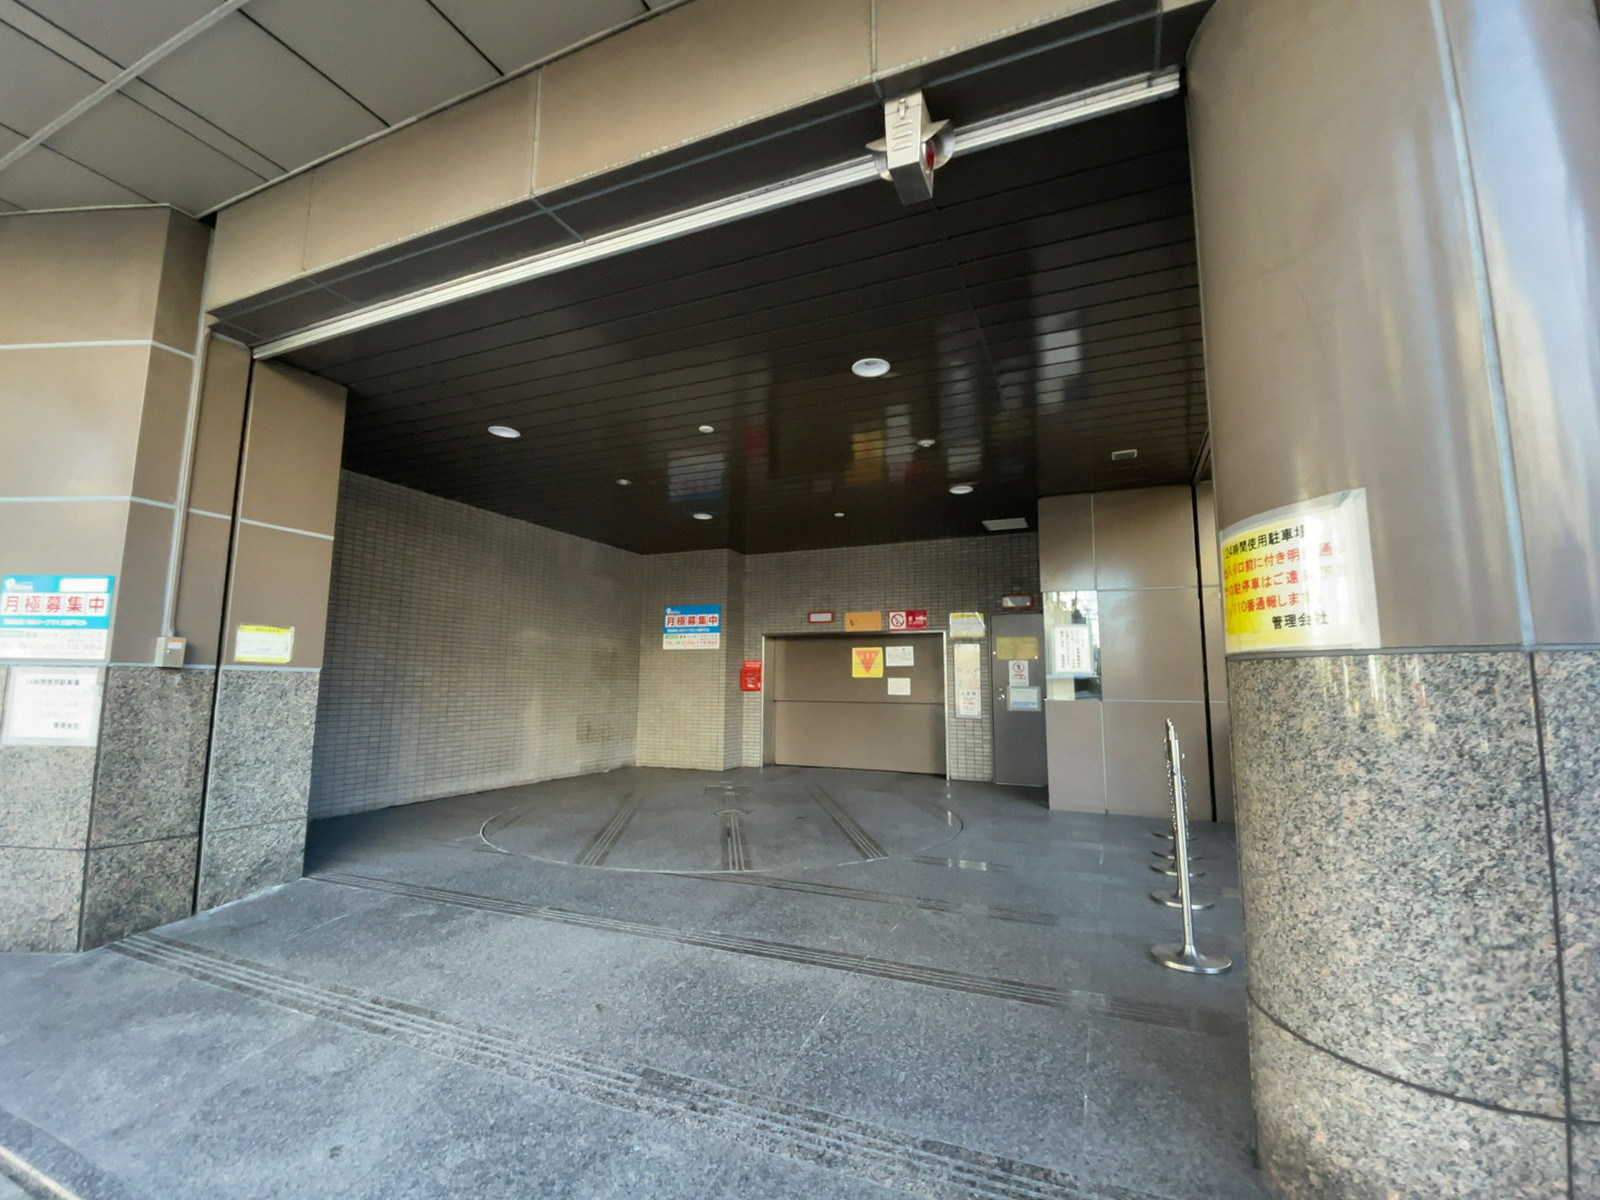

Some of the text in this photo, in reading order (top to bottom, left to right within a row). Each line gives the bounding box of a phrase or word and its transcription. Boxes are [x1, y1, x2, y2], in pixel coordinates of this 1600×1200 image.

[4, 595, 105, 613] 月極募集中
[667, 616, 717, 626] 月極募集中
[1272, 611, 1329, 630] 管理会社
